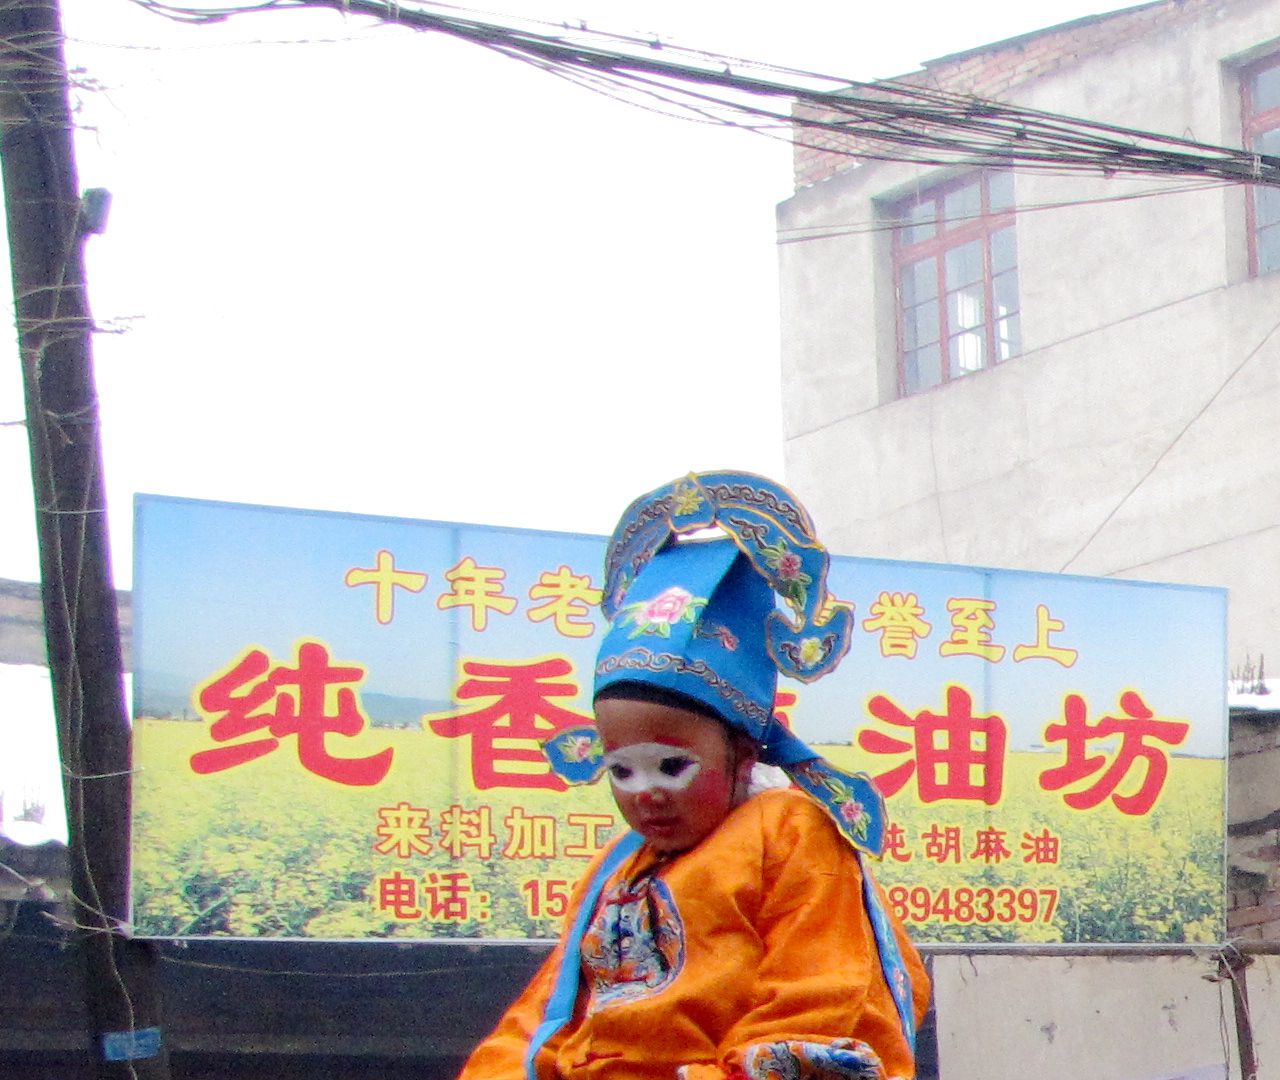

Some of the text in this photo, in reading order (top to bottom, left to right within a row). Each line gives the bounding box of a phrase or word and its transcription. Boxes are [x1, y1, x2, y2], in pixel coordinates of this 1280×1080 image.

[814, 591, 1078, 668] 誉至上
[375, 802, 614, 860] 来料加工
[523, 878, 578, 918] 15
